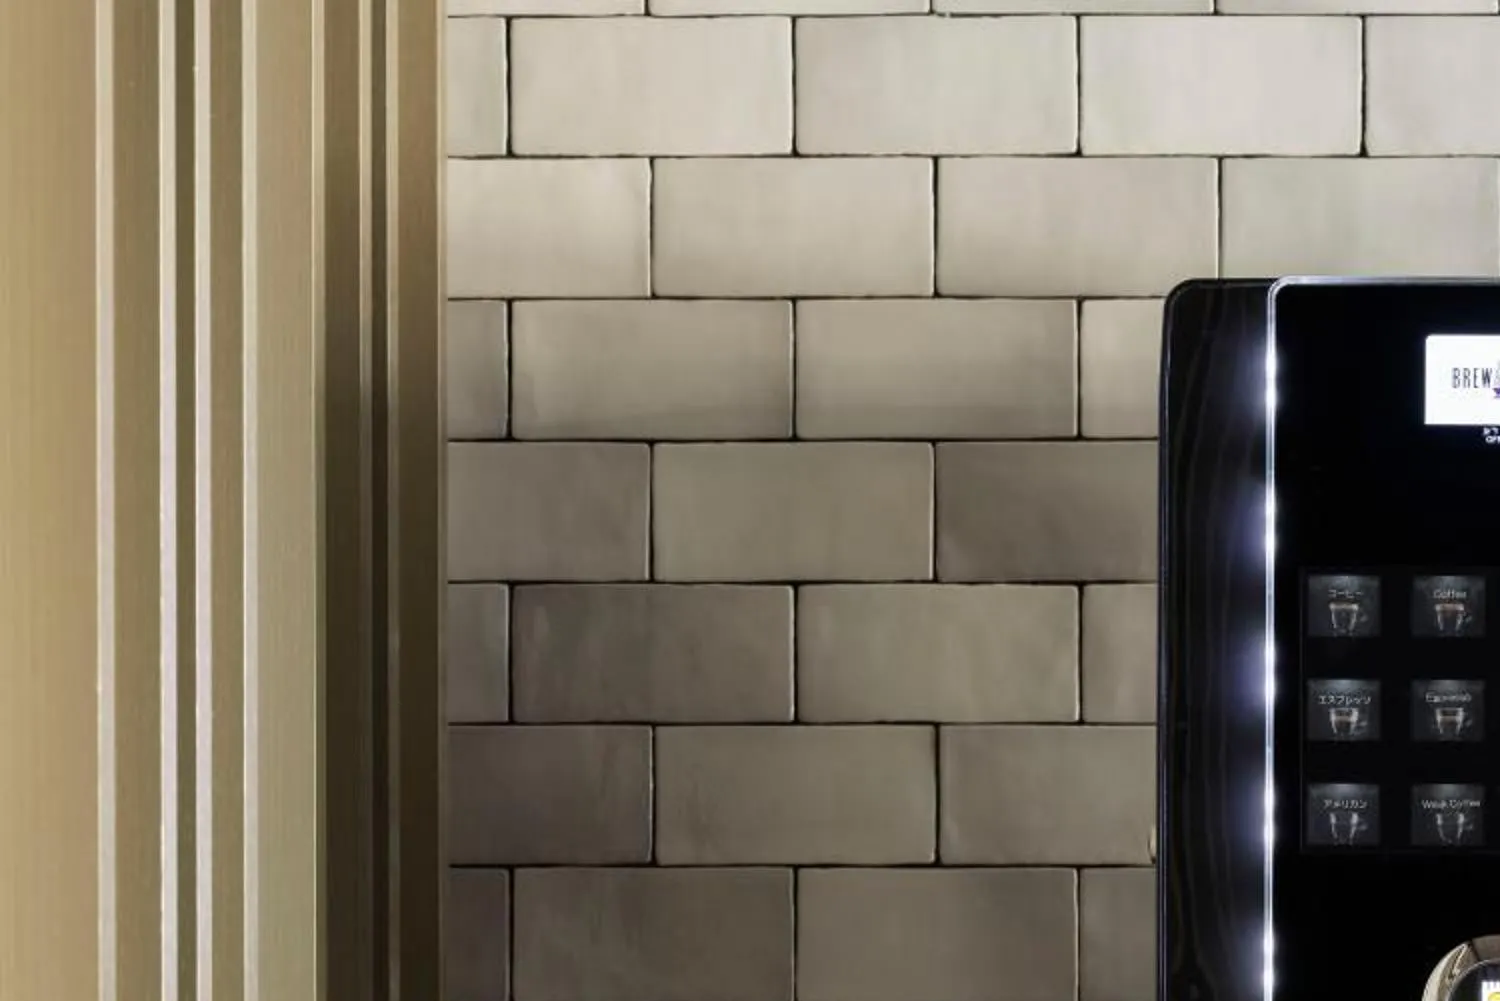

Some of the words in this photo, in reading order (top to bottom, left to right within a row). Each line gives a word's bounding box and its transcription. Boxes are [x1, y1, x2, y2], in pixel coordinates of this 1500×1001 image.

[1451, 367, 1494, 389] BREW
[1322, 799, 1368, 809] アメリカン
